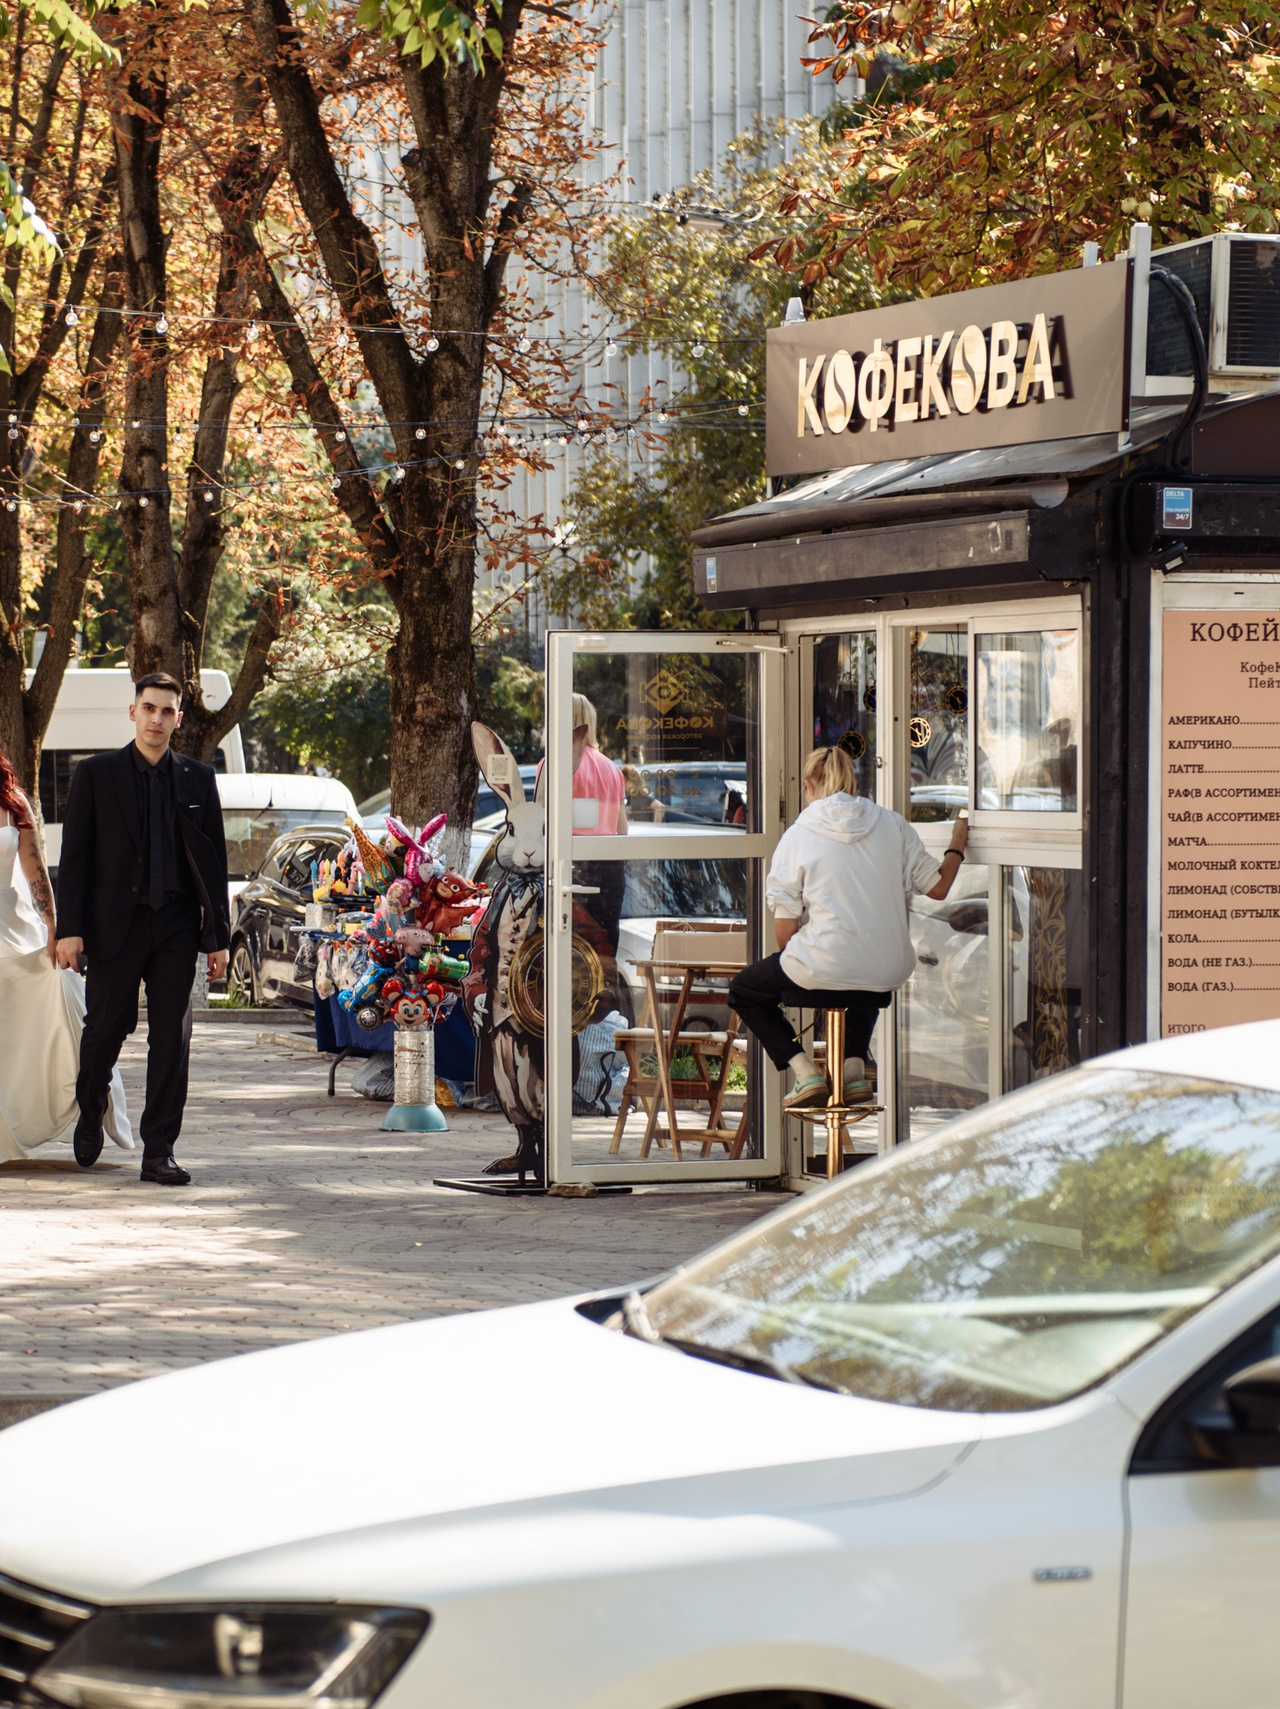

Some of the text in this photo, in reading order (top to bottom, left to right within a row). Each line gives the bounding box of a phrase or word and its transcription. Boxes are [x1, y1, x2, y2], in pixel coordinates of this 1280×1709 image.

[797, 313, 1055, 438] КОФЕКОВА
[1190, 618, 1280, 642] КОФЕЙ
[1168, 716, 1240, 725] АМЕРИКАНО
[1168, 740, 1232, 750] КАПУЧИНО
[1168, 764, 1204, 773] ЛАТТЕ
[1168, 837, 1207, 846] МАТЧА
[1167, 859, 1280, 870] МОЛОЧНЫЙ КОКТЕ
[1167, 885, 1280, 895] ЛИМОНАД (СОБСТВ
[1167, 909, 1227, 919] ЛИМОНАД
[1168, 934, 1199, 943] КОЛА
[1168, 958, 1199, 968] ВОДА
[1202, 957, 1222, 968] (НЕ
[1168, 982, 1199, 992] ВОДА
[1168, 1024, 1206, 1033] ИТОГО
